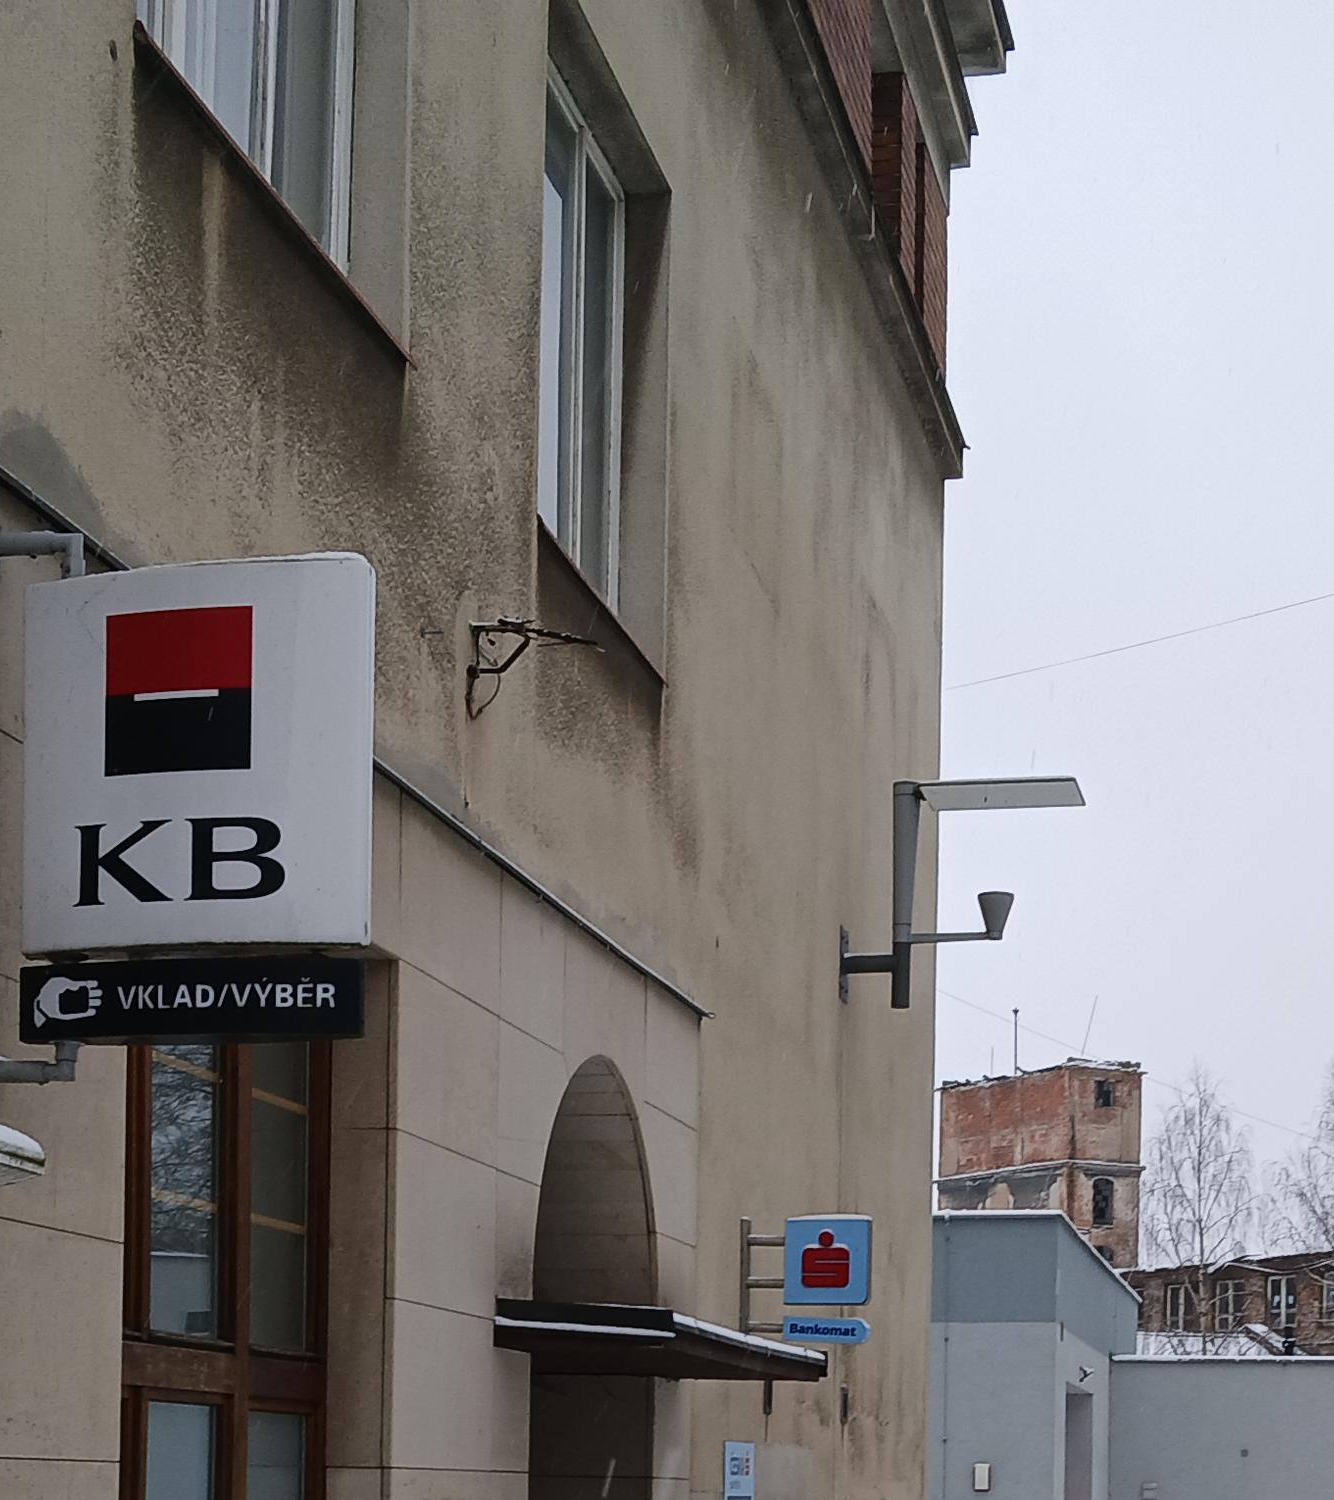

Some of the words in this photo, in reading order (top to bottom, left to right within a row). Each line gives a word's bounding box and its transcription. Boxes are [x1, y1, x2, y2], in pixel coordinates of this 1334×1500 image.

[72, 817, 286, 907] KB
[117, 976, 336, 1010] VKLAD/VÝBĚR
[789, 1323, 857, 1337] Bankomat
